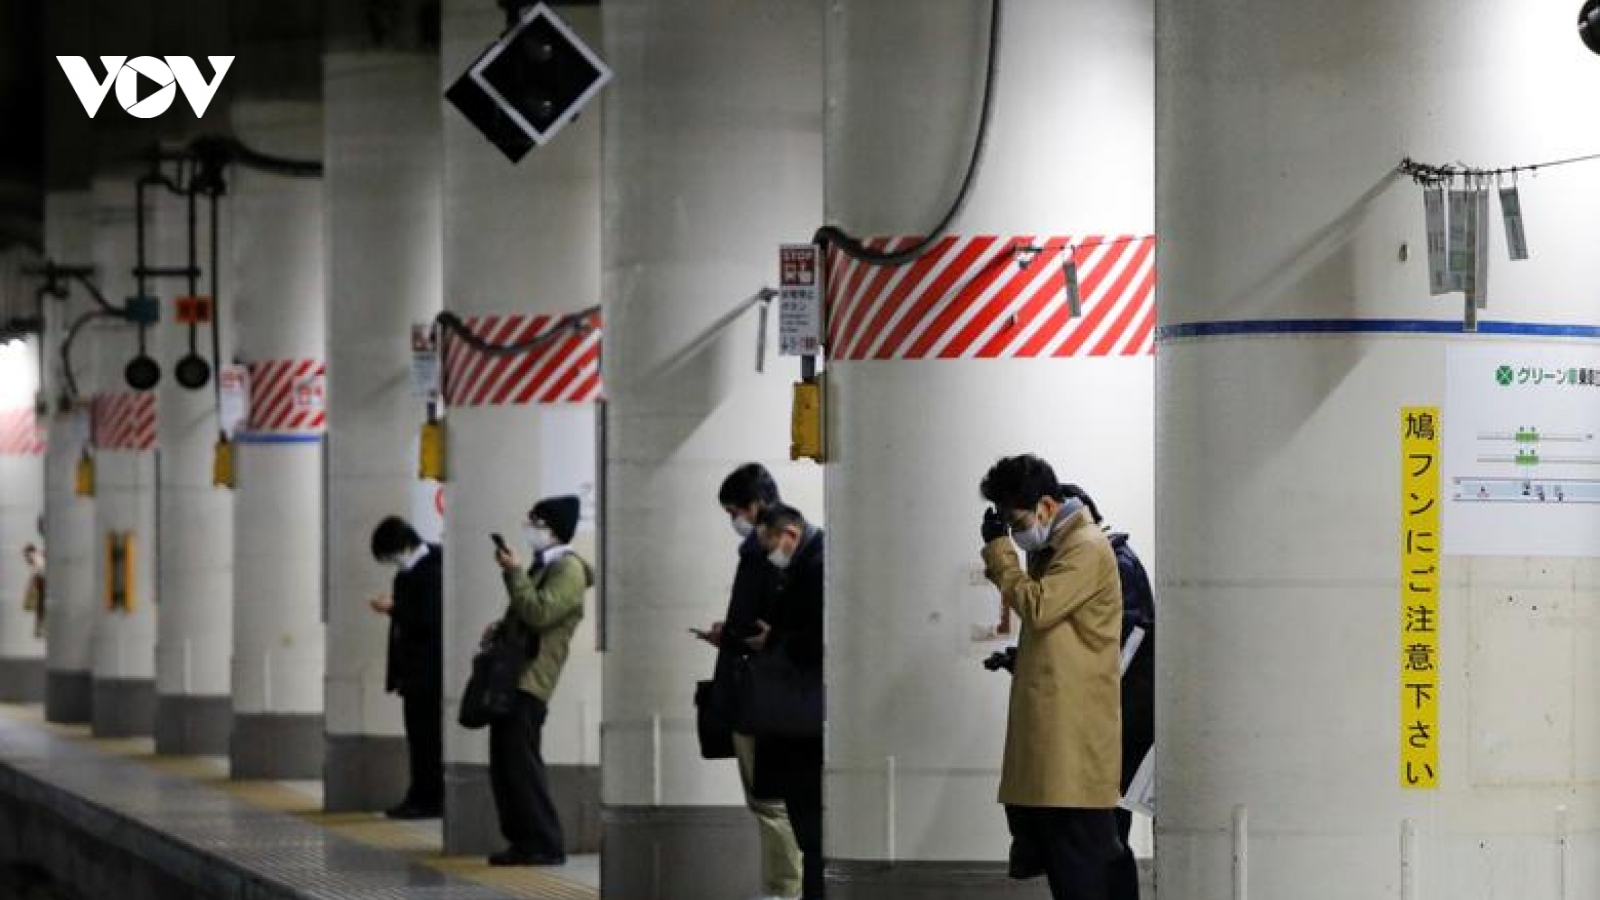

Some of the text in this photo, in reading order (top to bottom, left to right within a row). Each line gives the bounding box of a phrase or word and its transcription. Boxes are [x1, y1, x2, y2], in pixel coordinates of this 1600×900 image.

[1404, 412, 1435, 784] 鳩フンにご注意下さい
